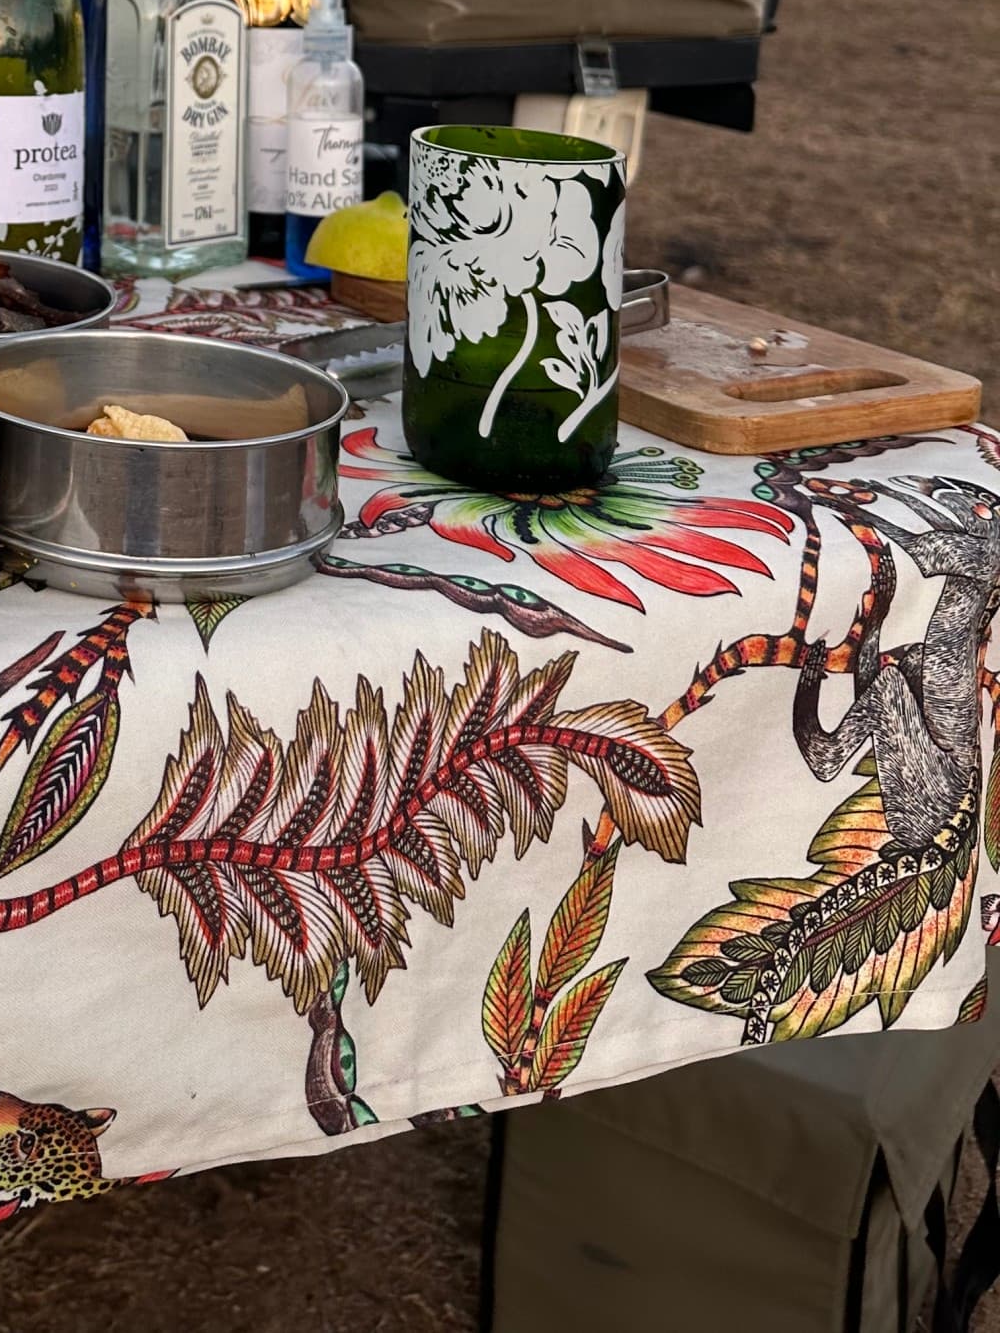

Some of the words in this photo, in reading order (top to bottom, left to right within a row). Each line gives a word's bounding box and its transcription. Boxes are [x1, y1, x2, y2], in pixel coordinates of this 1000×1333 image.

[180, 36, 232, 66] BOMBAY
[182, 106, 205, 128] DRY
[206, 102, 229, 126] GIN
[13, 141, 77, 170] protea
[289, 166, 336, 186] Hand
